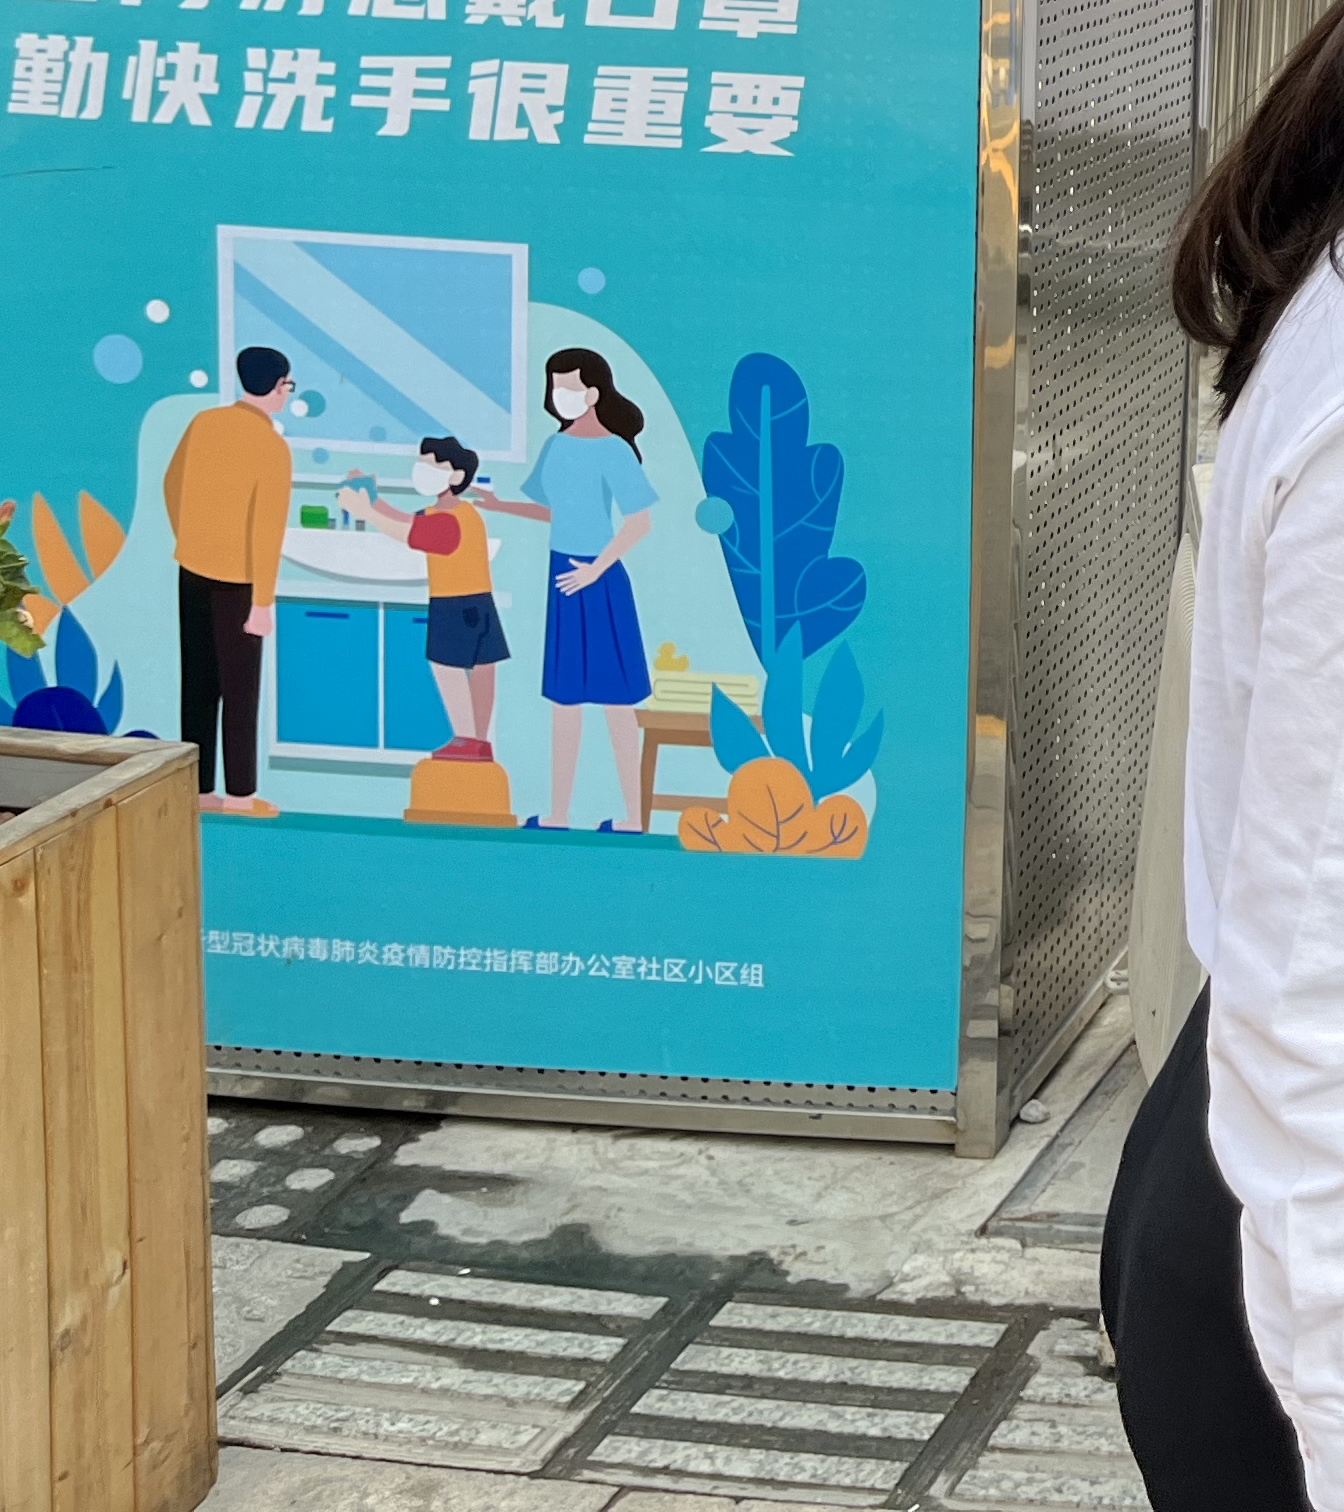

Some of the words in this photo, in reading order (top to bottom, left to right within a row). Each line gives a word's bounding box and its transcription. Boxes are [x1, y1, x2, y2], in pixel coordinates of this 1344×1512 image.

[7, 34, 805, 157] 勤快洗手很重要
[200, 929, 764, 987] 型冠状病毒肺炎疫情防控指挥部办公室社区小区组
